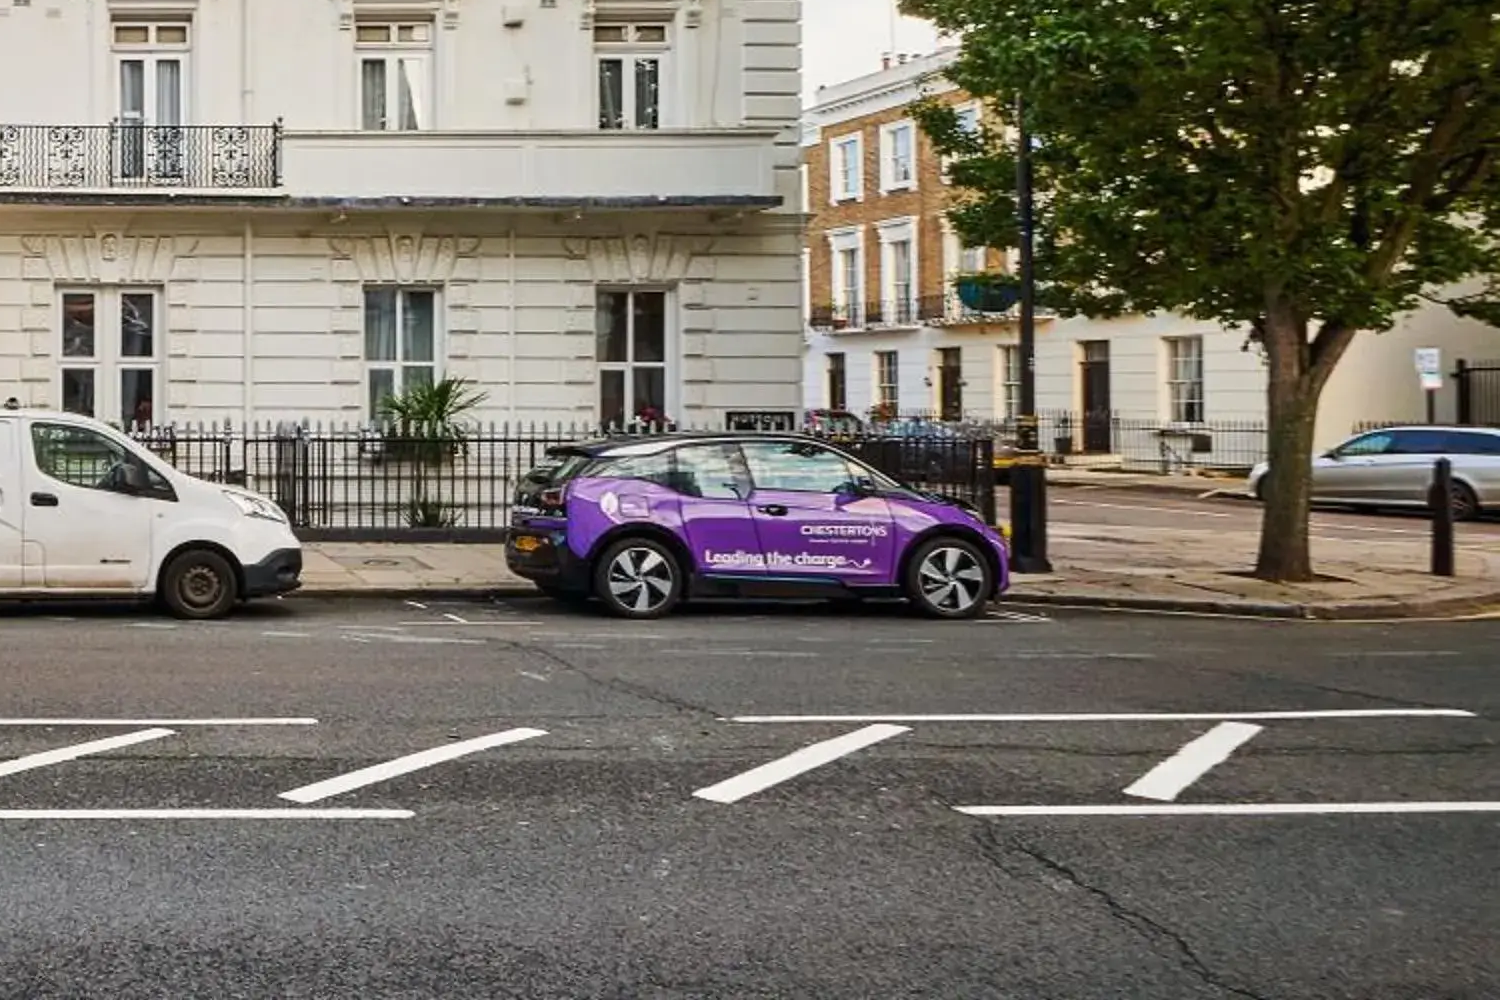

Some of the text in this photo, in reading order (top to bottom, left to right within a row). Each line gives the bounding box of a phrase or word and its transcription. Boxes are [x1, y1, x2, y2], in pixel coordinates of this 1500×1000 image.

[801, 525, 887, 536] CHESTERTONS
[705, 549, 846, 568] Leading the charge
